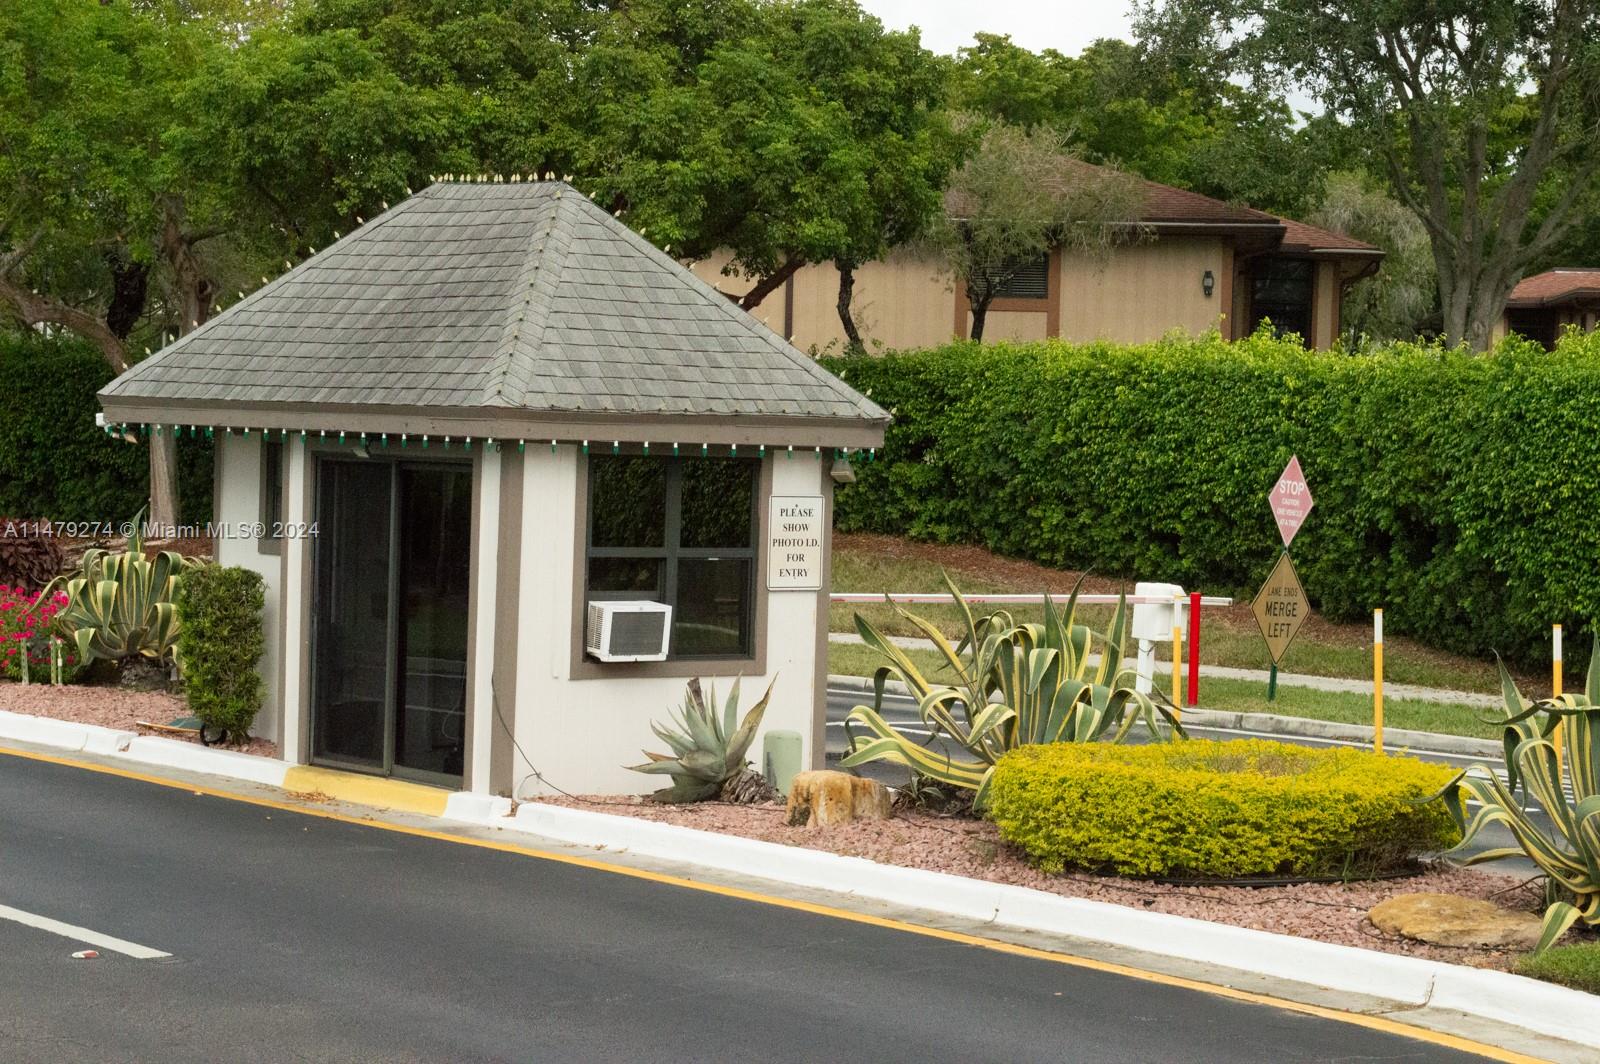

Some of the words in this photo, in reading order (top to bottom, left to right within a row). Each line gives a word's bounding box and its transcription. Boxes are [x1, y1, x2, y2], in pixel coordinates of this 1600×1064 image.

[1280, 480, 1305, 496] STOP
[780, 508, 814, 517] PLEASE
[782, 523, 809, 532] SHOW
[772, 538, 804, 547] PHOTO
[786, 553, 805, 562] FOR
[779, 568, 809, 577] ENTRY
[1267, 586, 1281, 597] LANE
[1284, 587, 1298, 598] ENDS
[1265, 601, 1298, 617] MERGE
[1267, 622, 1292, 638] LEFT
